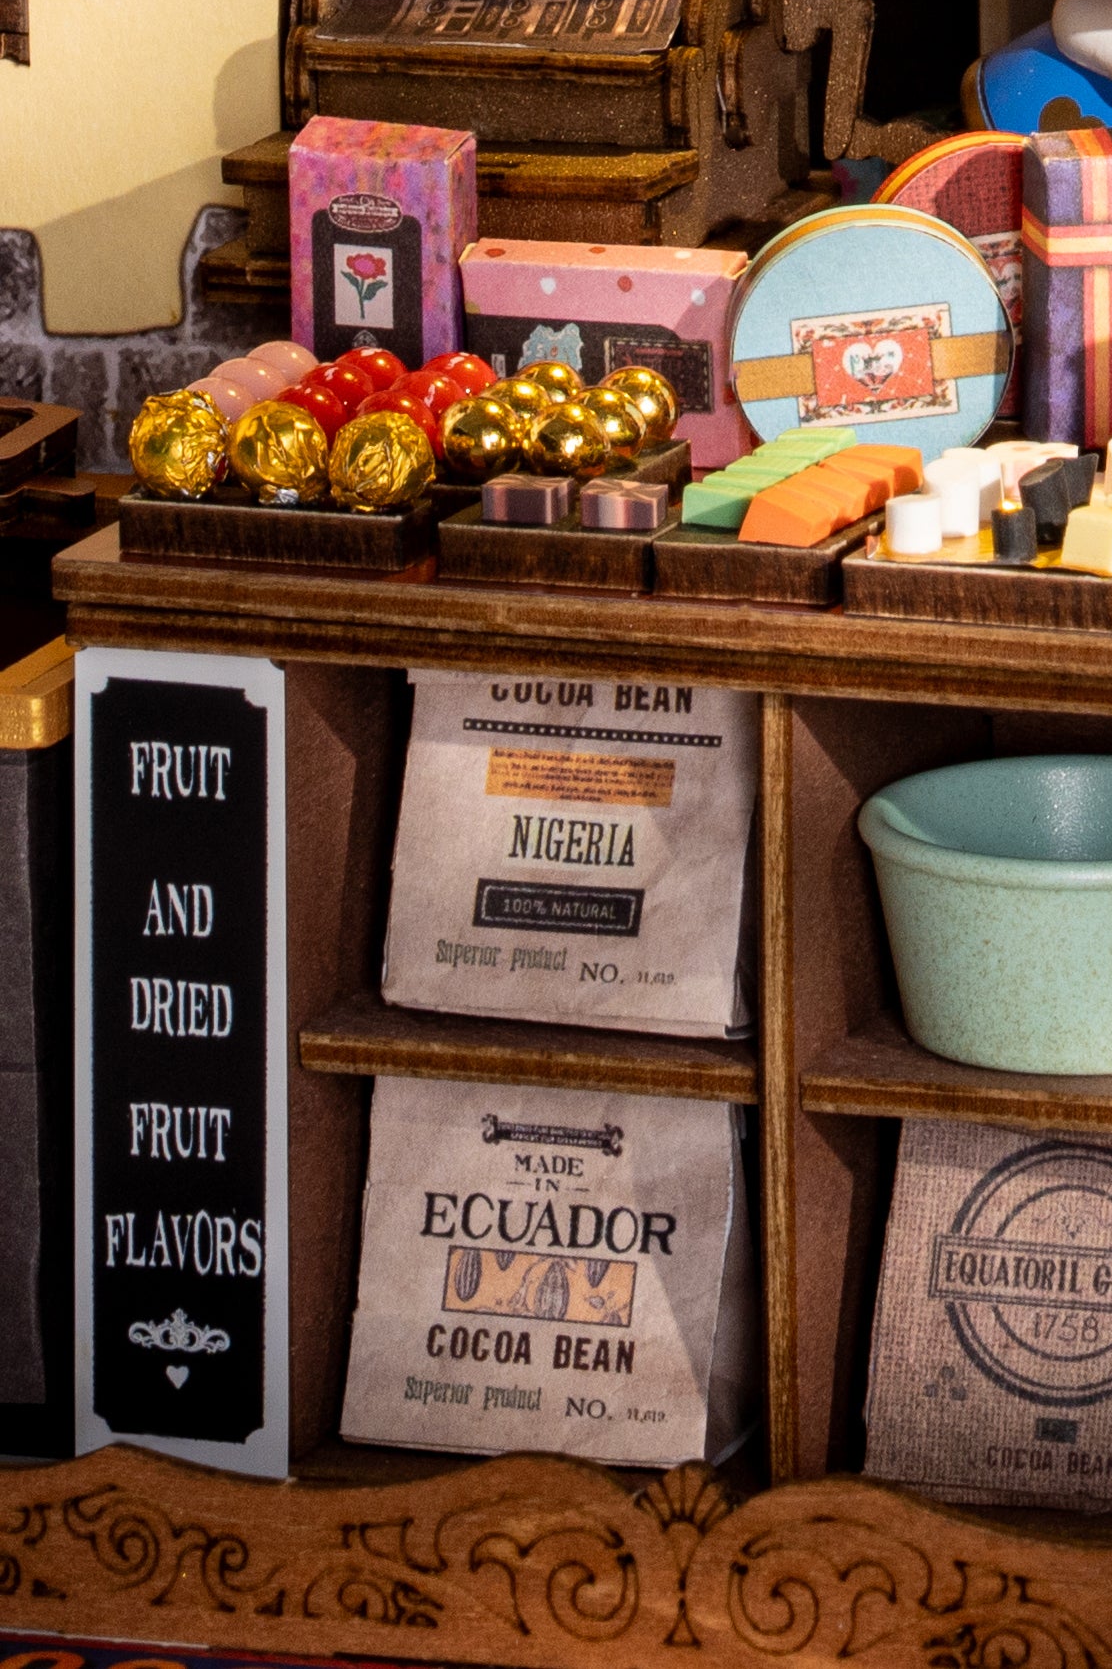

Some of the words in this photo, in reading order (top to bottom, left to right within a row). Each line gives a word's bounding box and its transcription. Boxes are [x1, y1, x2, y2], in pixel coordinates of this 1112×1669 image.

[615, 685, 693, 714] BEAN
[130, 742, 231, 800] FRUIT
[508, 815, 636, 867] NIGERIA
[143, 880, 213, 937] AND
[503, 897, 547, 915] 100%
[552, 900, 617, 920] NATURAL
[579, 962, 624, 984] NO.
[130, 978, 232, 1037] DRIED
[130, 1103, 230, 1161] FRUIT
[515, 1154, 584, 1177] MADE
[105, 1209, 263, 1277] FLAVORS
[420, 1191, 677, 1256] ECUADOR
[426, 1324, 531, 1366] COCOA
[553, 1334, 635, 1374] BEAN
[1033, 1312, 1100, 1343] 1758
[404, 1375, 473, 1405] Superior
[564, 1397, 613, 1421] NO.
[986, 1445, 1052, 1471] COCOA
